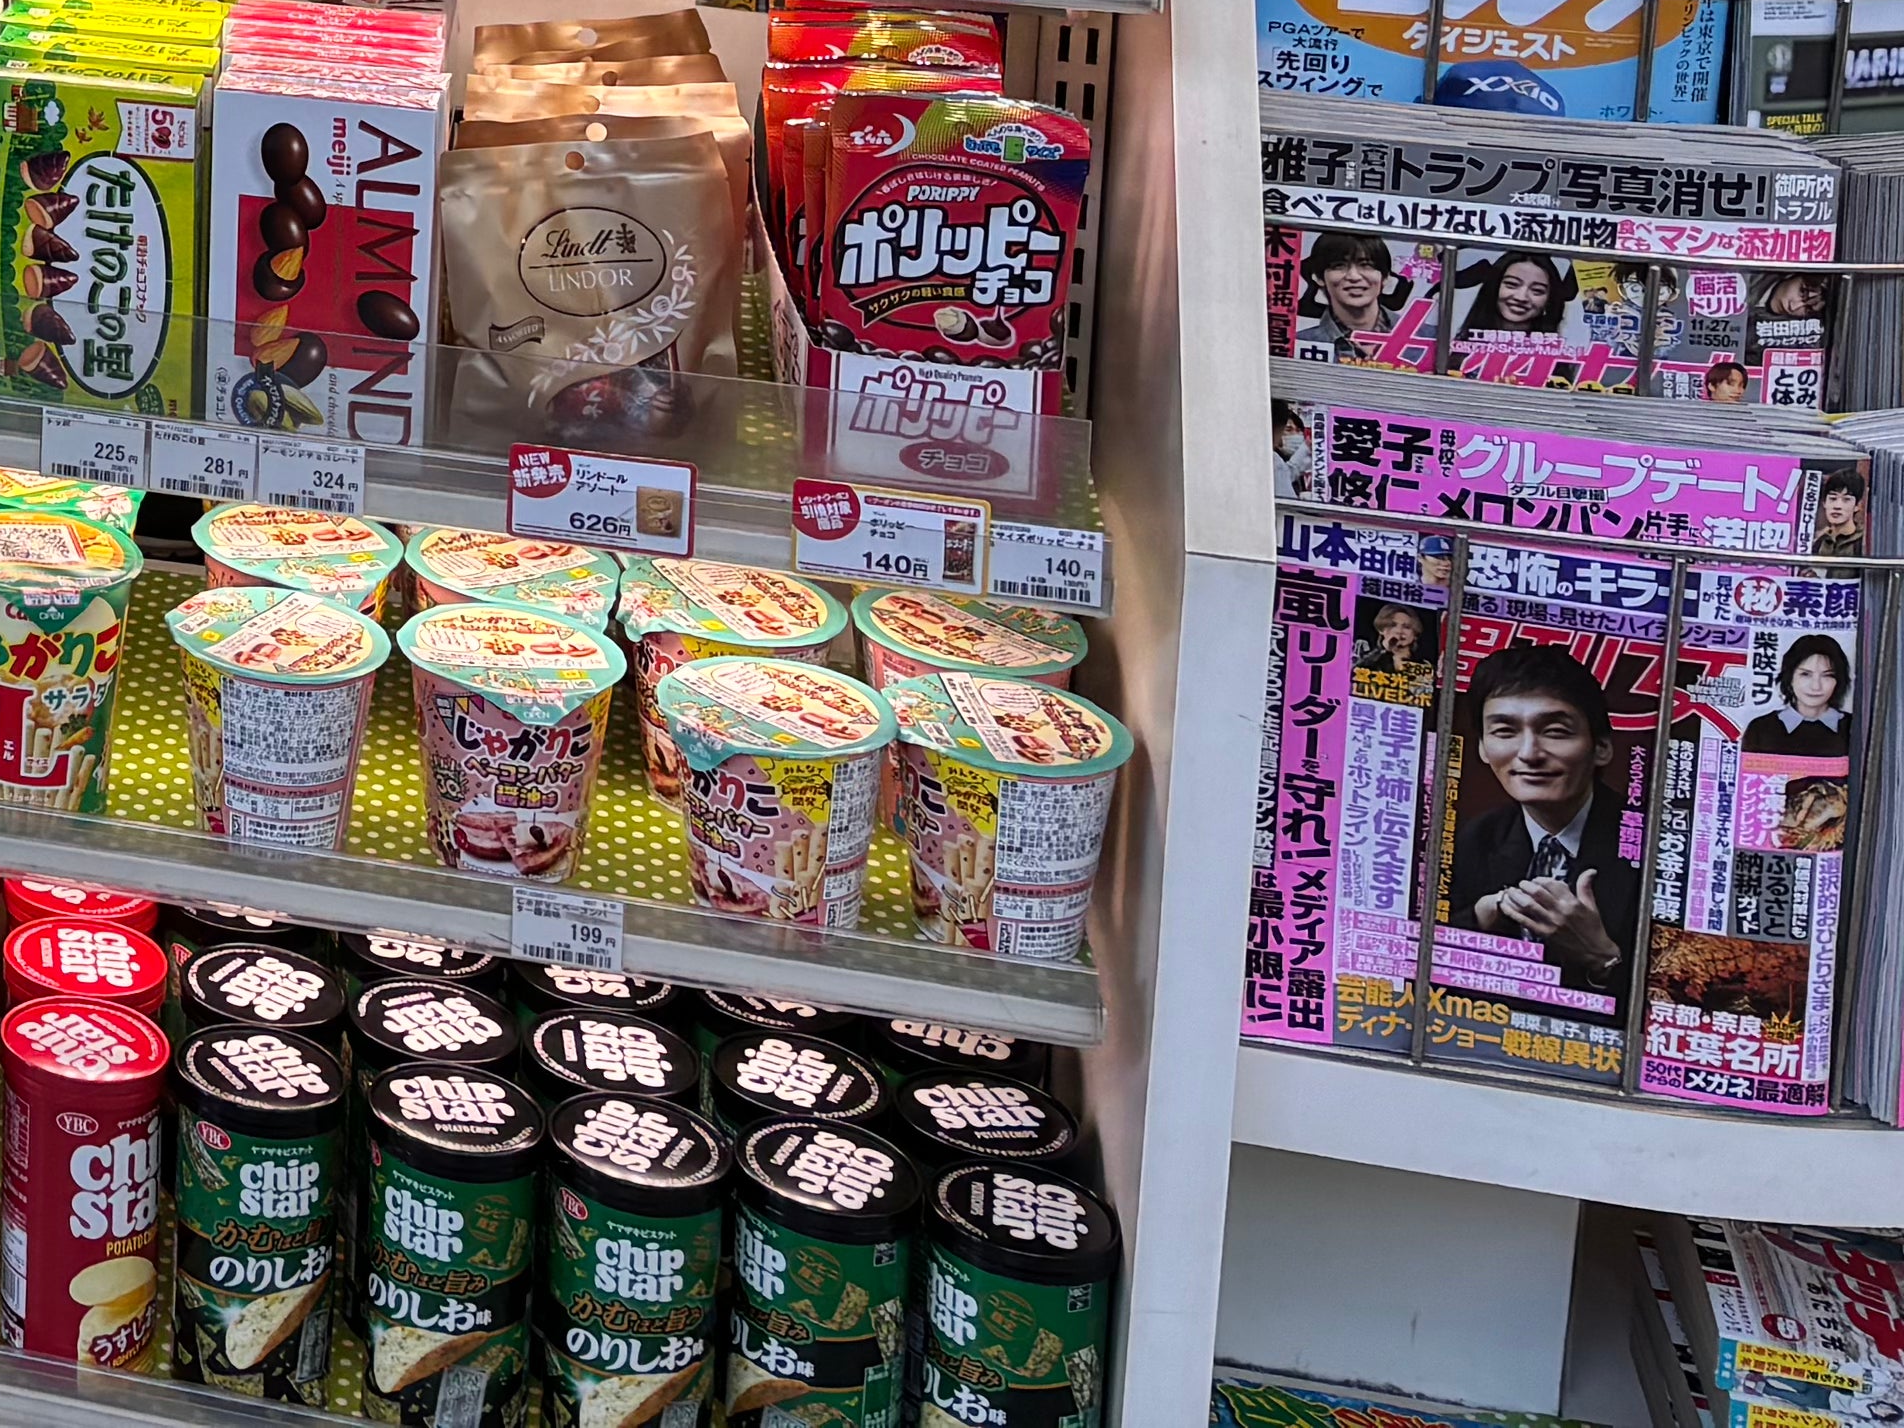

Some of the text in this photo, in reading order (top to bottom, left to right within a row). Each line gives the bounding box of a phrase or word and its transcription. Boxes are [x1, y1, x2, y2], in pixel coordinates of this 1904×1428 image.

[329, 117, 350, 177] meiji
[907, 185, 980, 203] PORIPPY
[1390, 147, 1556, 196] トランプ
[1558, 164, 1767, 218] 写真消せ!
[1774, 174, 1834, 198] 御所内
[1774, 197, 1832, 221] トラブル
[839, 198, 1060, 287] ポリッピー
[548, 267, 634, 292] LINDOR
[972, 267, 1055, 305] チョコ
[1331, 415, 1434, 469] 愛子
[1459, 433, 1802, 516] グループデート!
[1782, 578, 1860, 619] 素顔
[1751, 630, 1774, 706] 柴咲コウ
[464, 756, 578, 788] ベーコンバター
[1644, 1025, 1802, 1078] 紅葉名所
[1684, 1064, 1754, 1098] メガネ
[1754, 1079, 1826, 1107] 最適解
[367, 1273, 493, 1332] のりしお味
